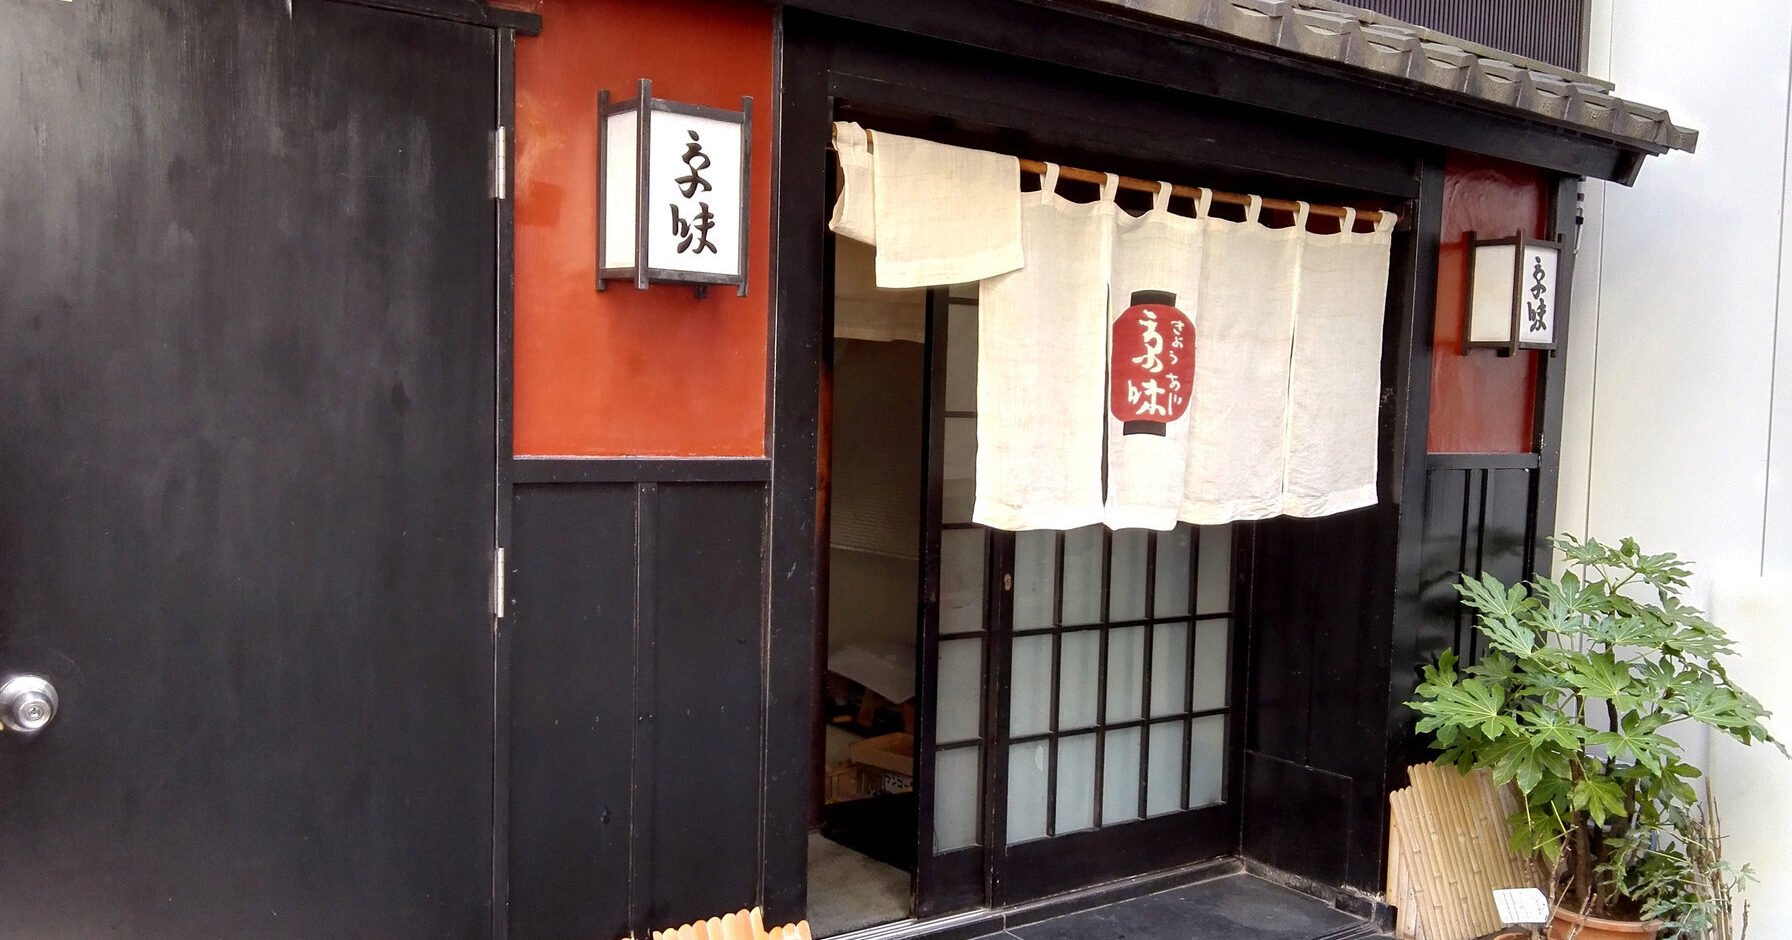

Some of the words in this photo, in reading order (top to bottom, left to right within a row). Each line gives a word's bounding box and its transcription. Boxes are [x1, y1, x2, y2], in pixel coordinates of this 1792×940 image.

[669, 130, 718, 255] 京味
[1526, 255, 1547, 333] 京味
[1127, 308, 1167, 417] 京味
